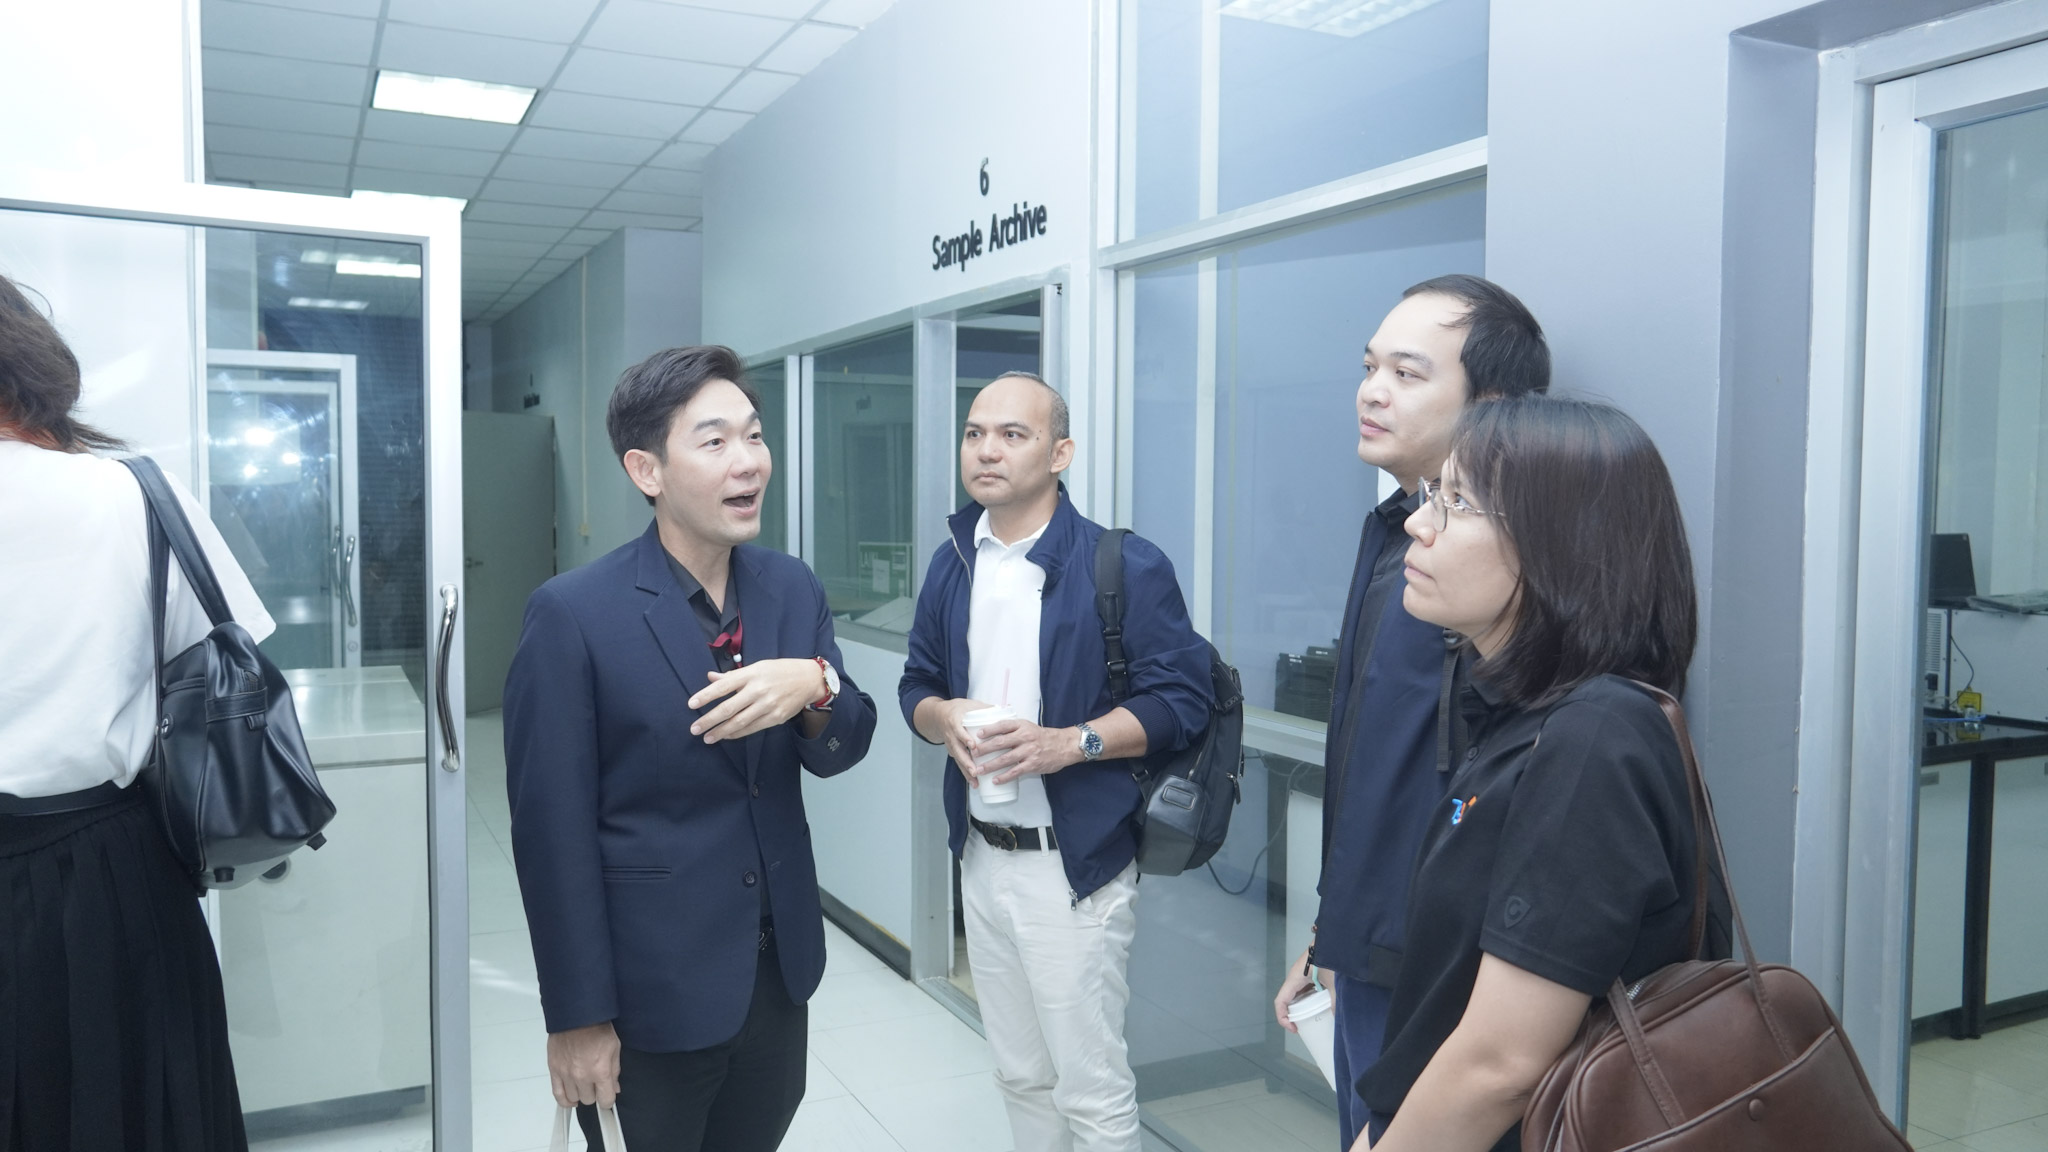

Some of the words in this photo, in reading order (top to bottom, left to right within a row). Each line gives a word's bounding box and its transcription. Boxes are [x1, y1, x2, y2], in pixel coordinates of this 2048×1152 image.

[980, 157, 989, 196] 6
[932, 220, 982, 272] Sample
[988, 201, 1047, 252] Archive
